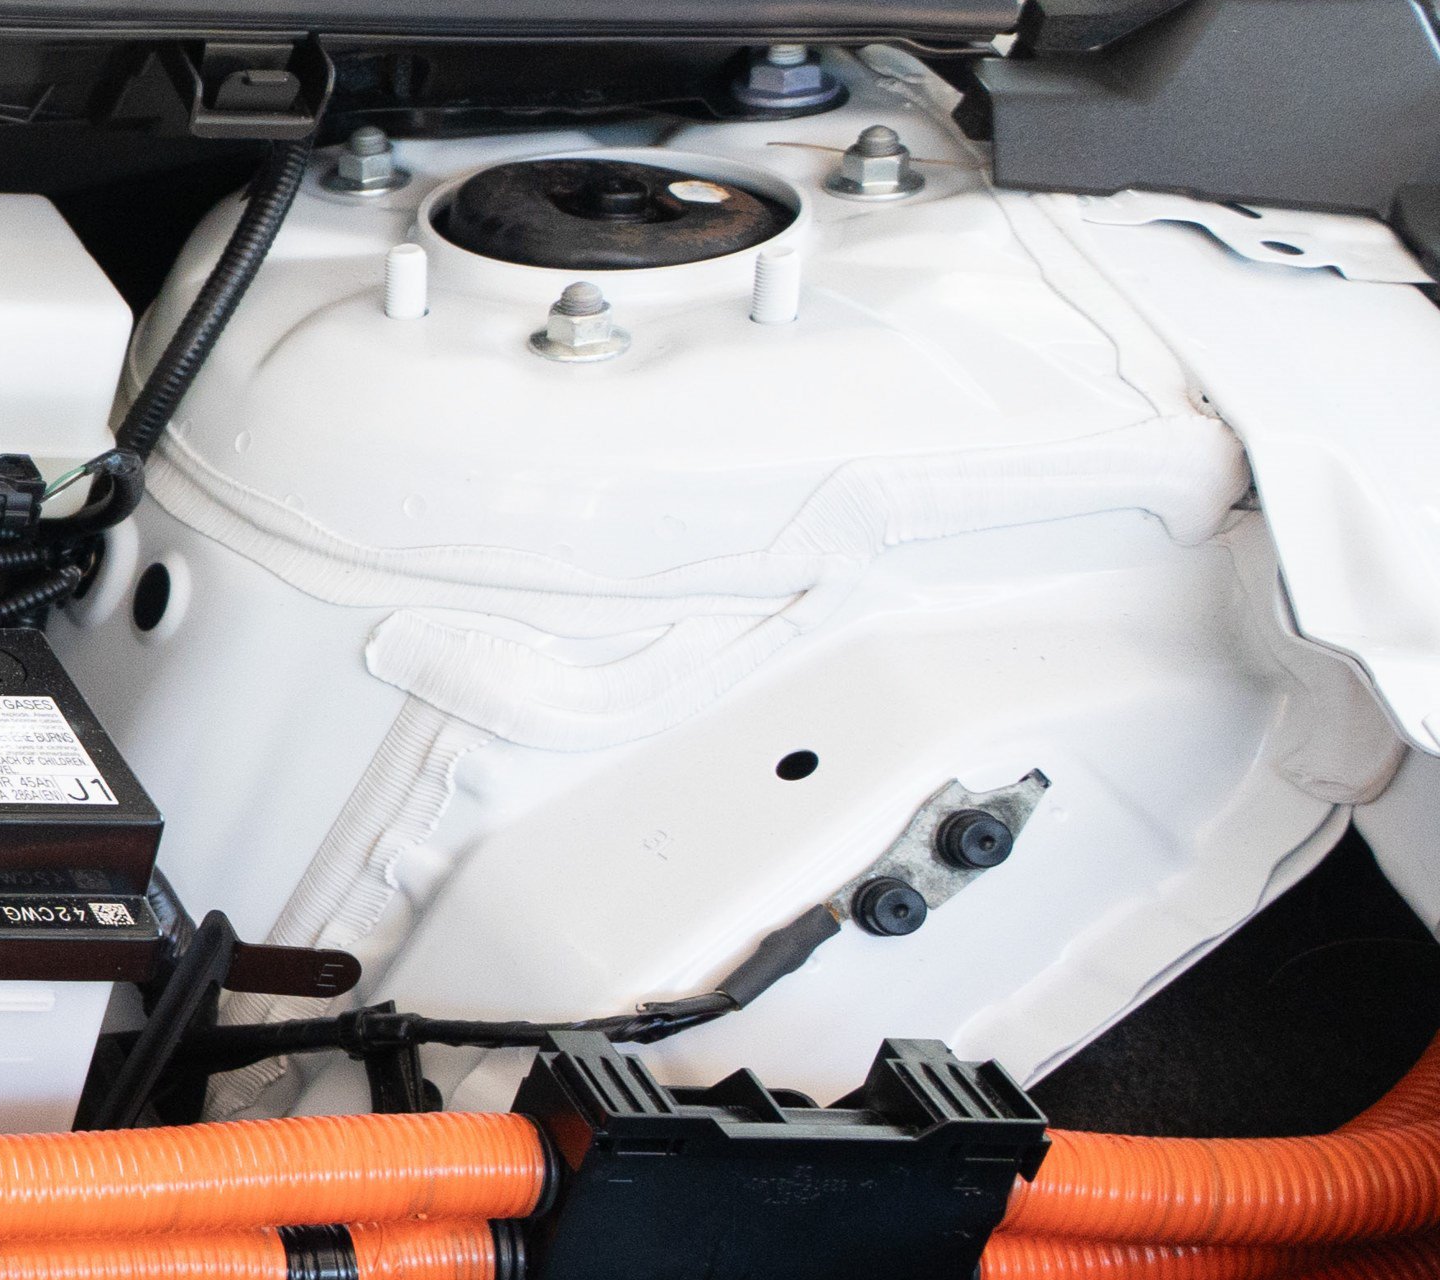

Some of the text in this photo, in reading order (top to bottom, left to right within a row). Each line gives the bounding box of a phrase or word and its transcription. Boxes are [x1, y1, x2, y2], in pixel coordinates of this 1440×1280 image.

[3, 699, 54, 710] GASES
[34, 732, 75, 744] BURNS
[22, 757, 35, 766] OF
[20, 777, 57, 789] 45Ah
[67, 777, 113, 802] J1
[2, 905, 85, 922] 42CWG
